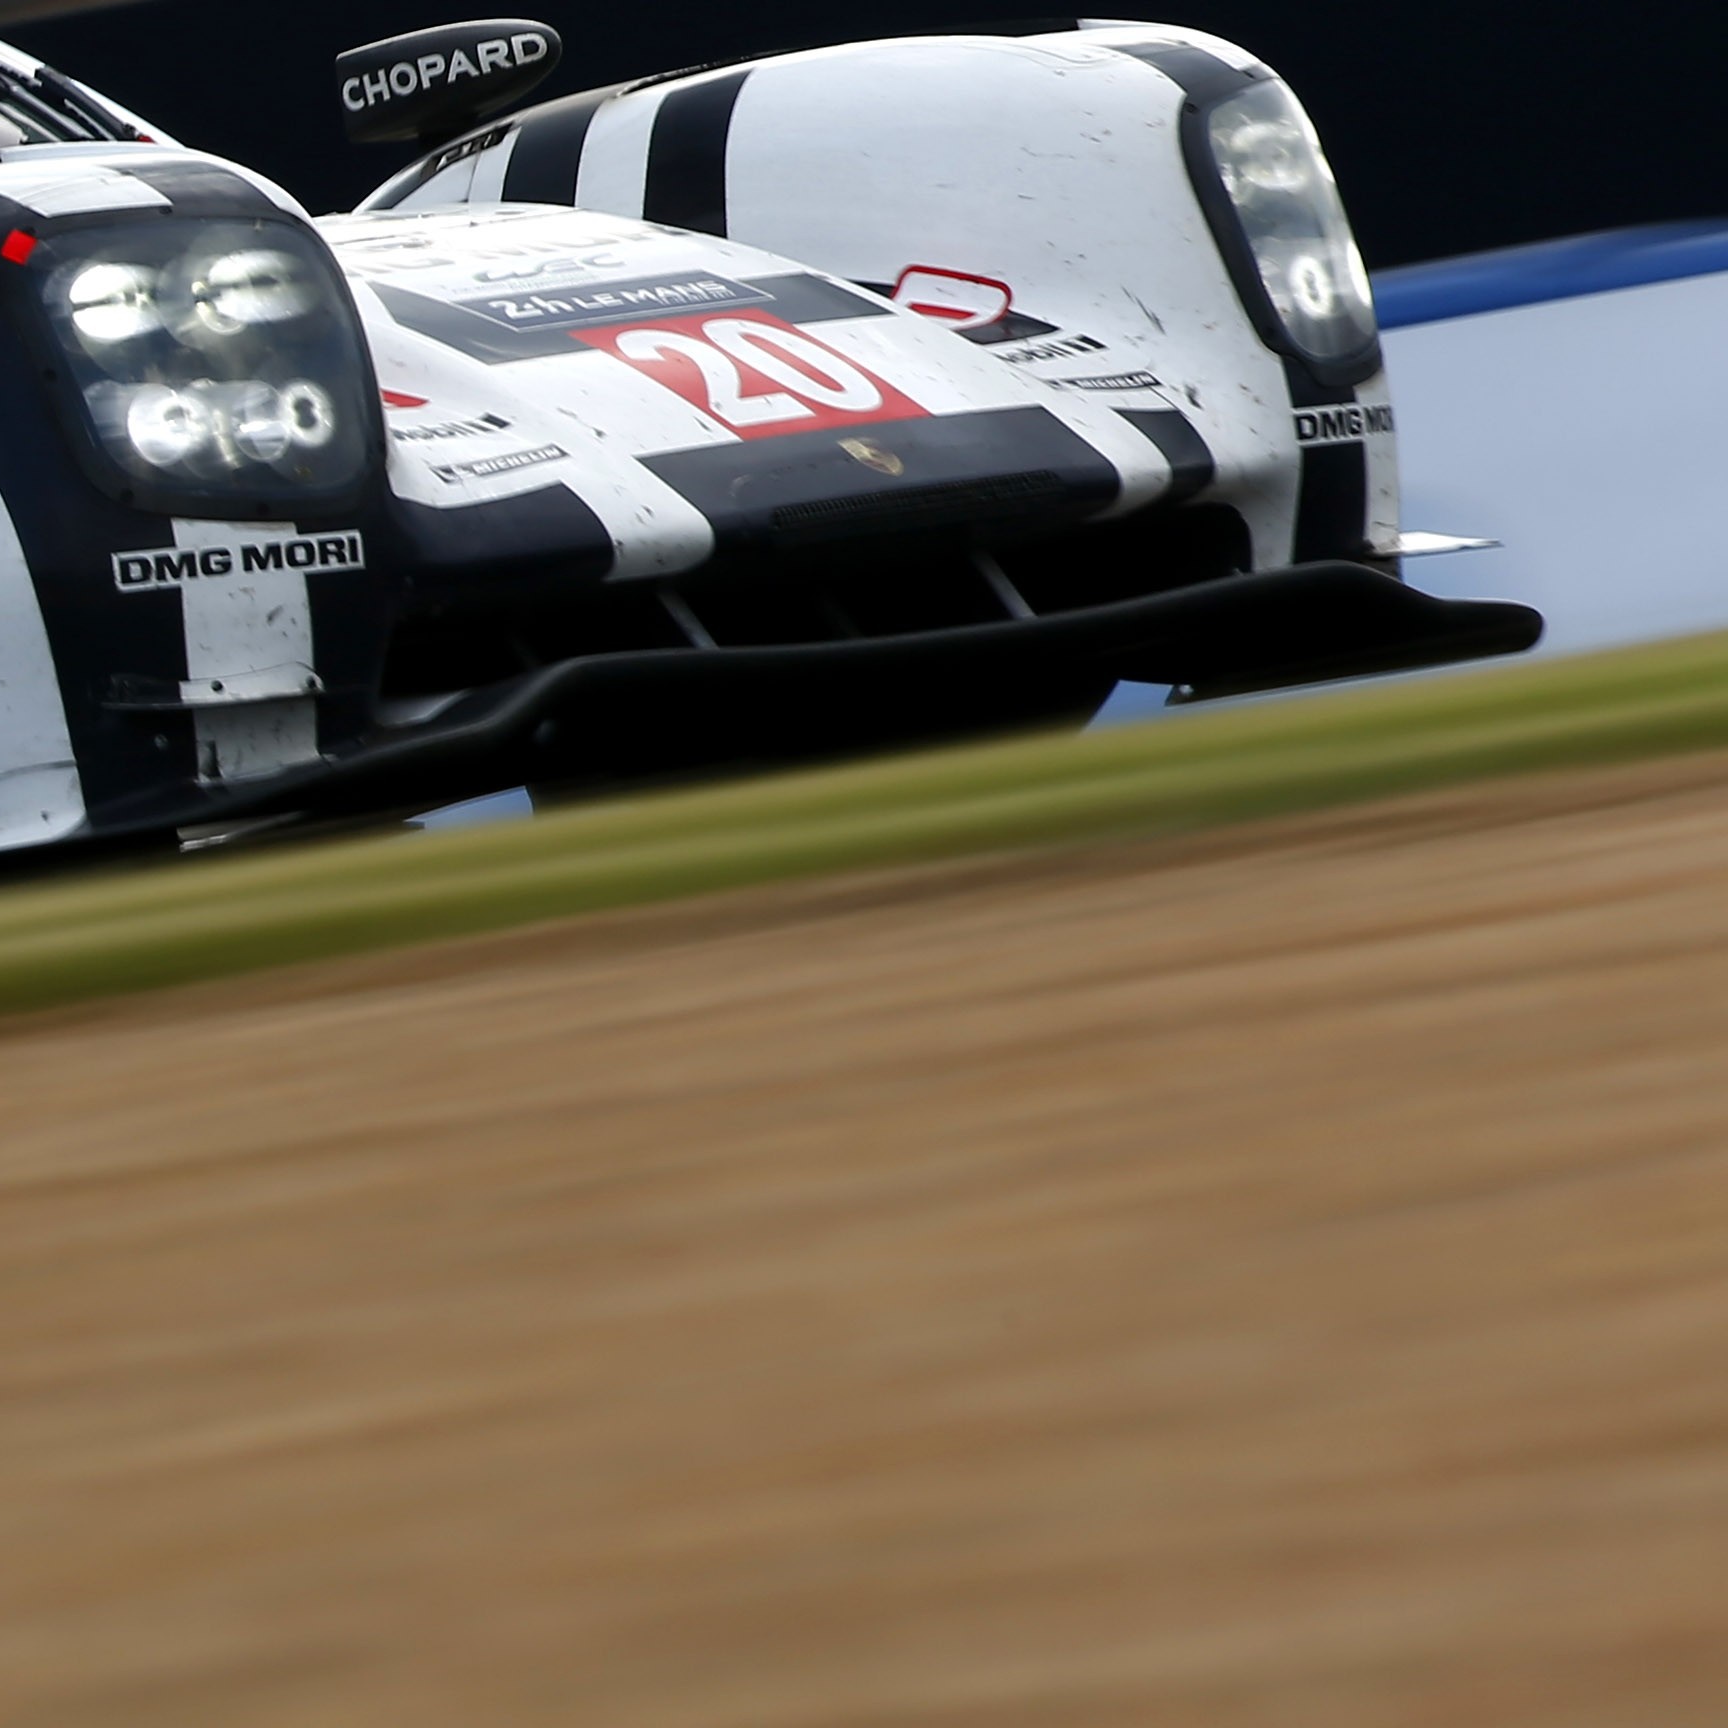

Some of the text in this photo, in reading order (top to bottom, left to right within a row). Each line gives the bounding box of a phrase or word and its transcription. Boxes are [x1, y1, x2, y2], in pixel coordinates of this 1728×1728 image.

[342, 31, 549, 113] CHOPARD
[573, 291, 621, 310] LE
[619, 279, 730, 304] MANS
[613, 317, 886, 428] 20
[1295, 408, 1362, 440] DMG
[471, 445, 561, 476] MICHELIN
[118, 535, 360, 584] DMG MORI
